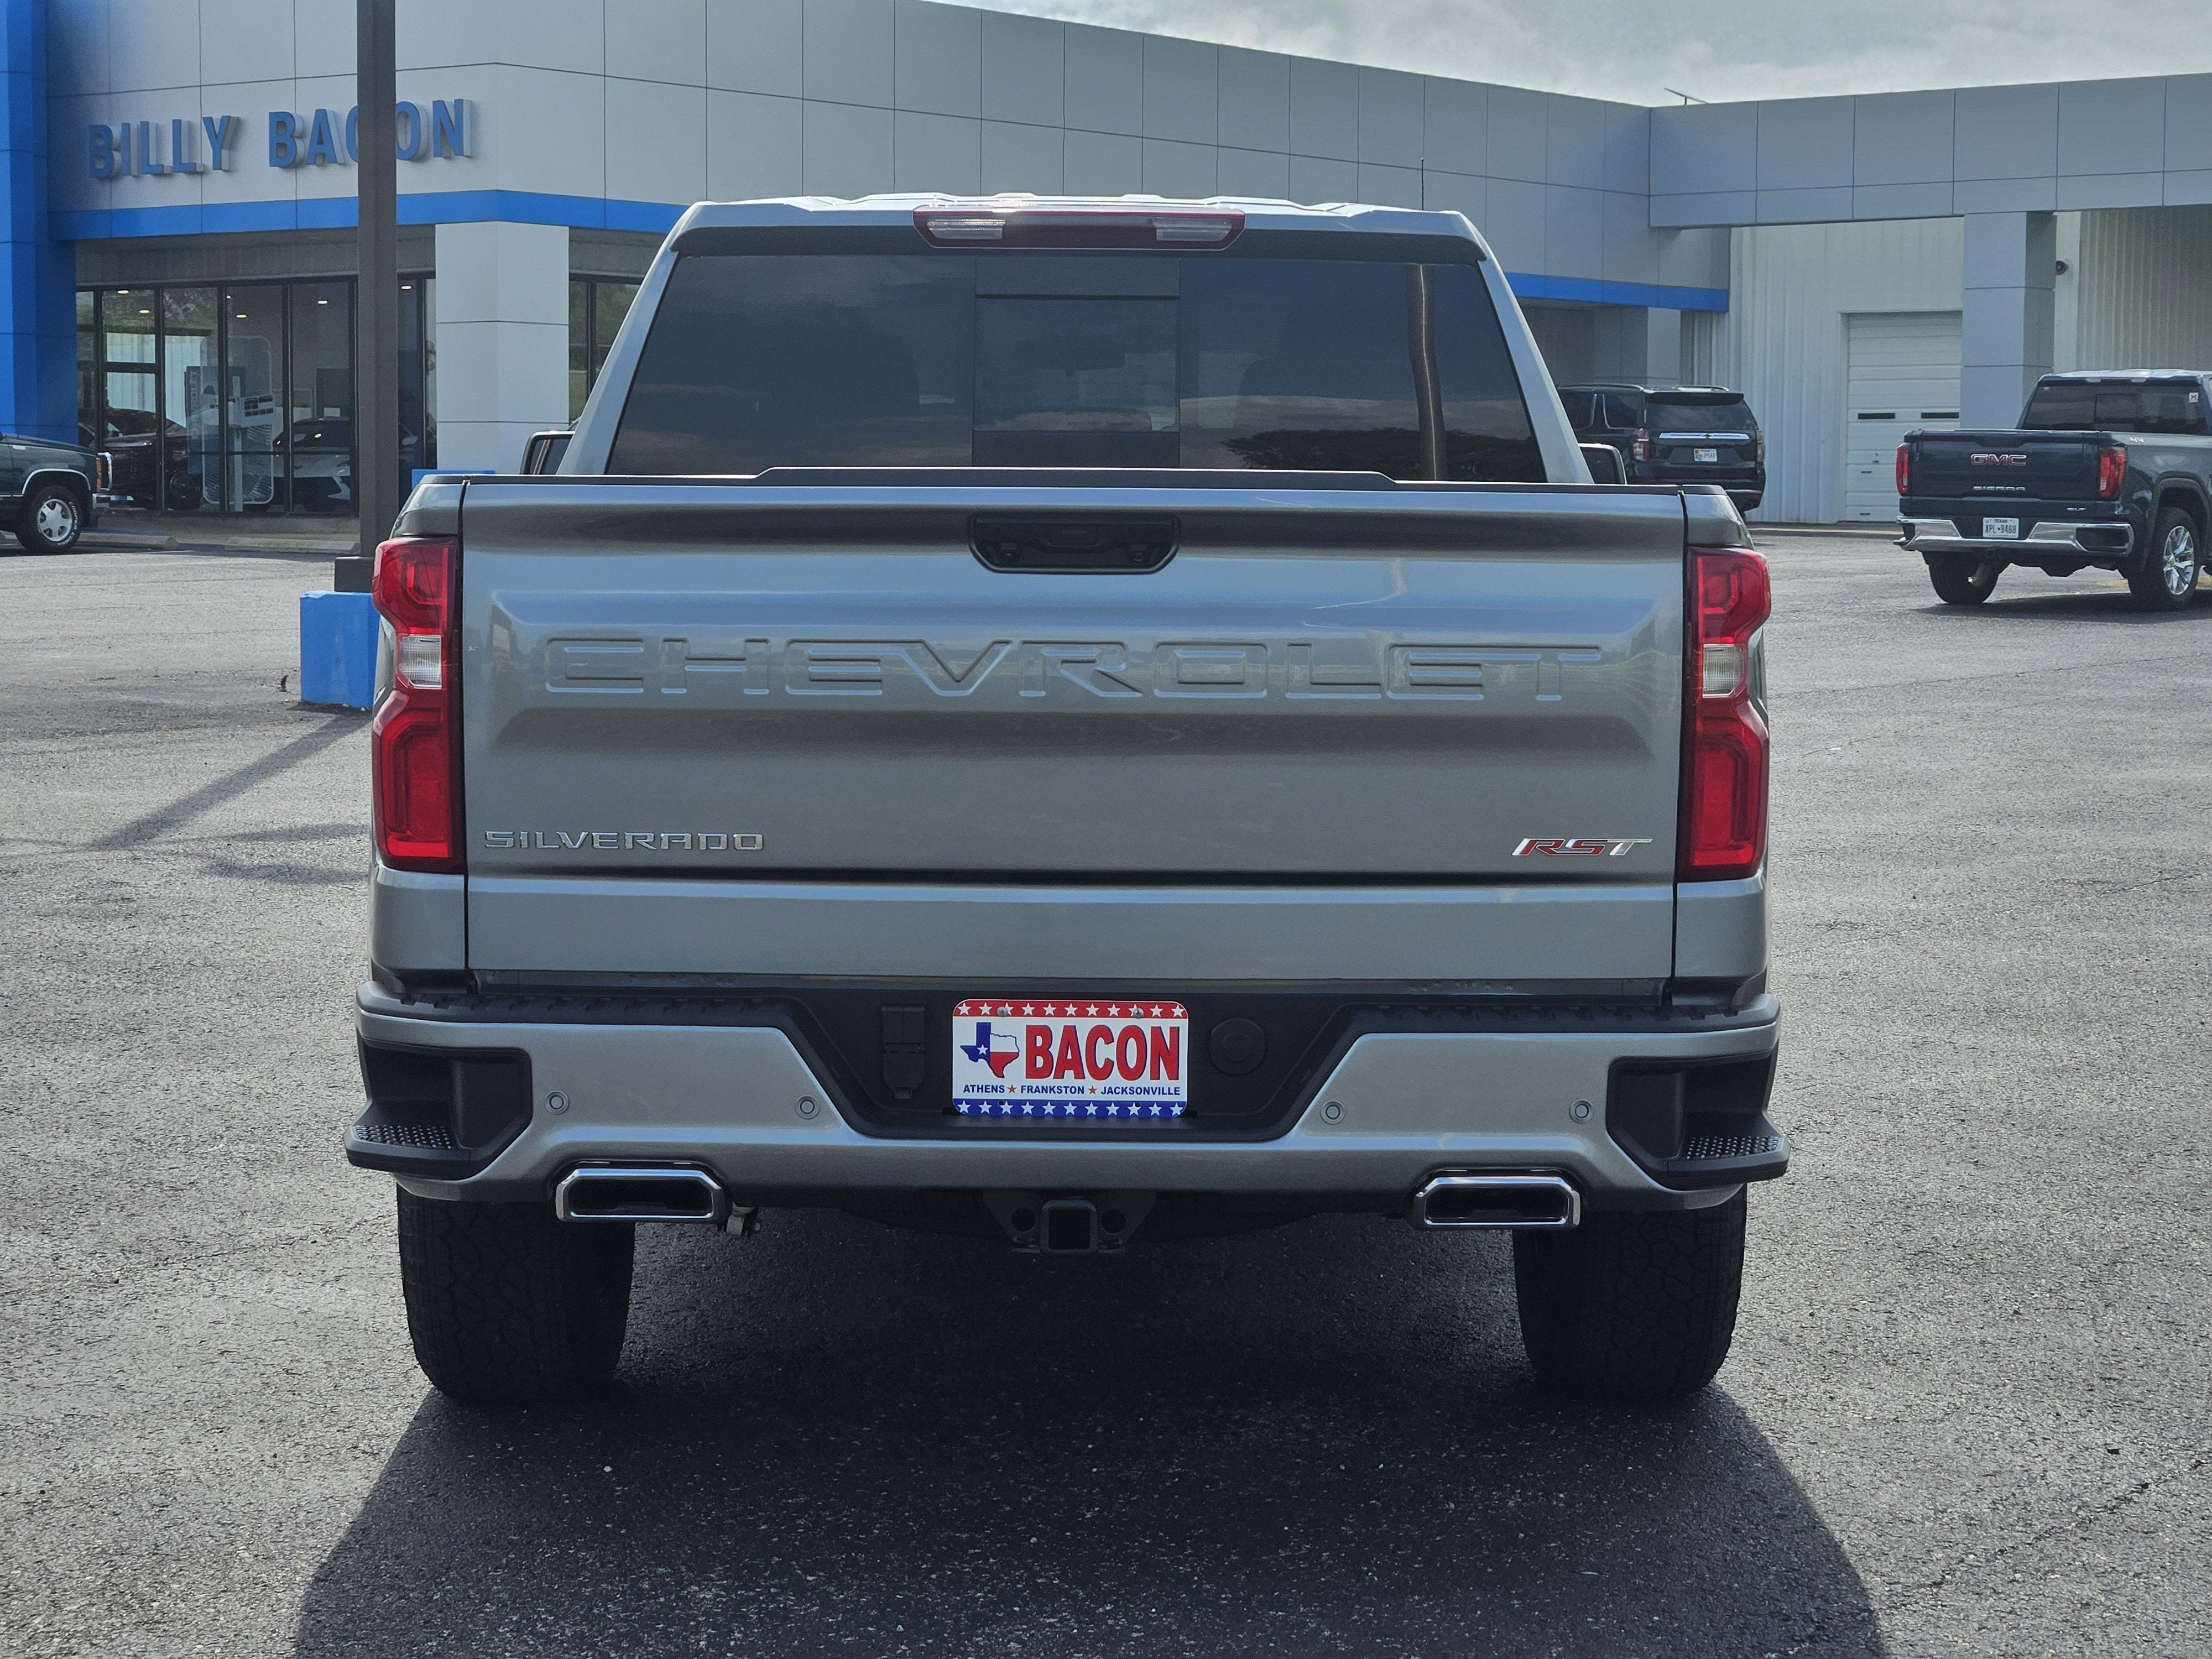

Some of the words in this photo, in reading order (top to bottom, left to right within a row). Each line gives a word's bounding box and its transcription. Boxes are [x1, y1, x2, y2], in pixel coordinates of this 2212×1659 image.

[88, 115, 234, 179] BILLY
[1970, 453, 2027, 466] GMC
[546, 638, 1601, 701] CHEVROLET
[484, 831, 764, 851] SILVERADO
[1512, 838, 1653, 856] RST
[1025, 1024, 1181, 1081] BACON
[963, 1084, 1005, 1094] ATHENS
[1020, 1085, 1085, 1095] FRANKSTON
[1100, 1086, 1181, 1096] JACKSONVILLE
